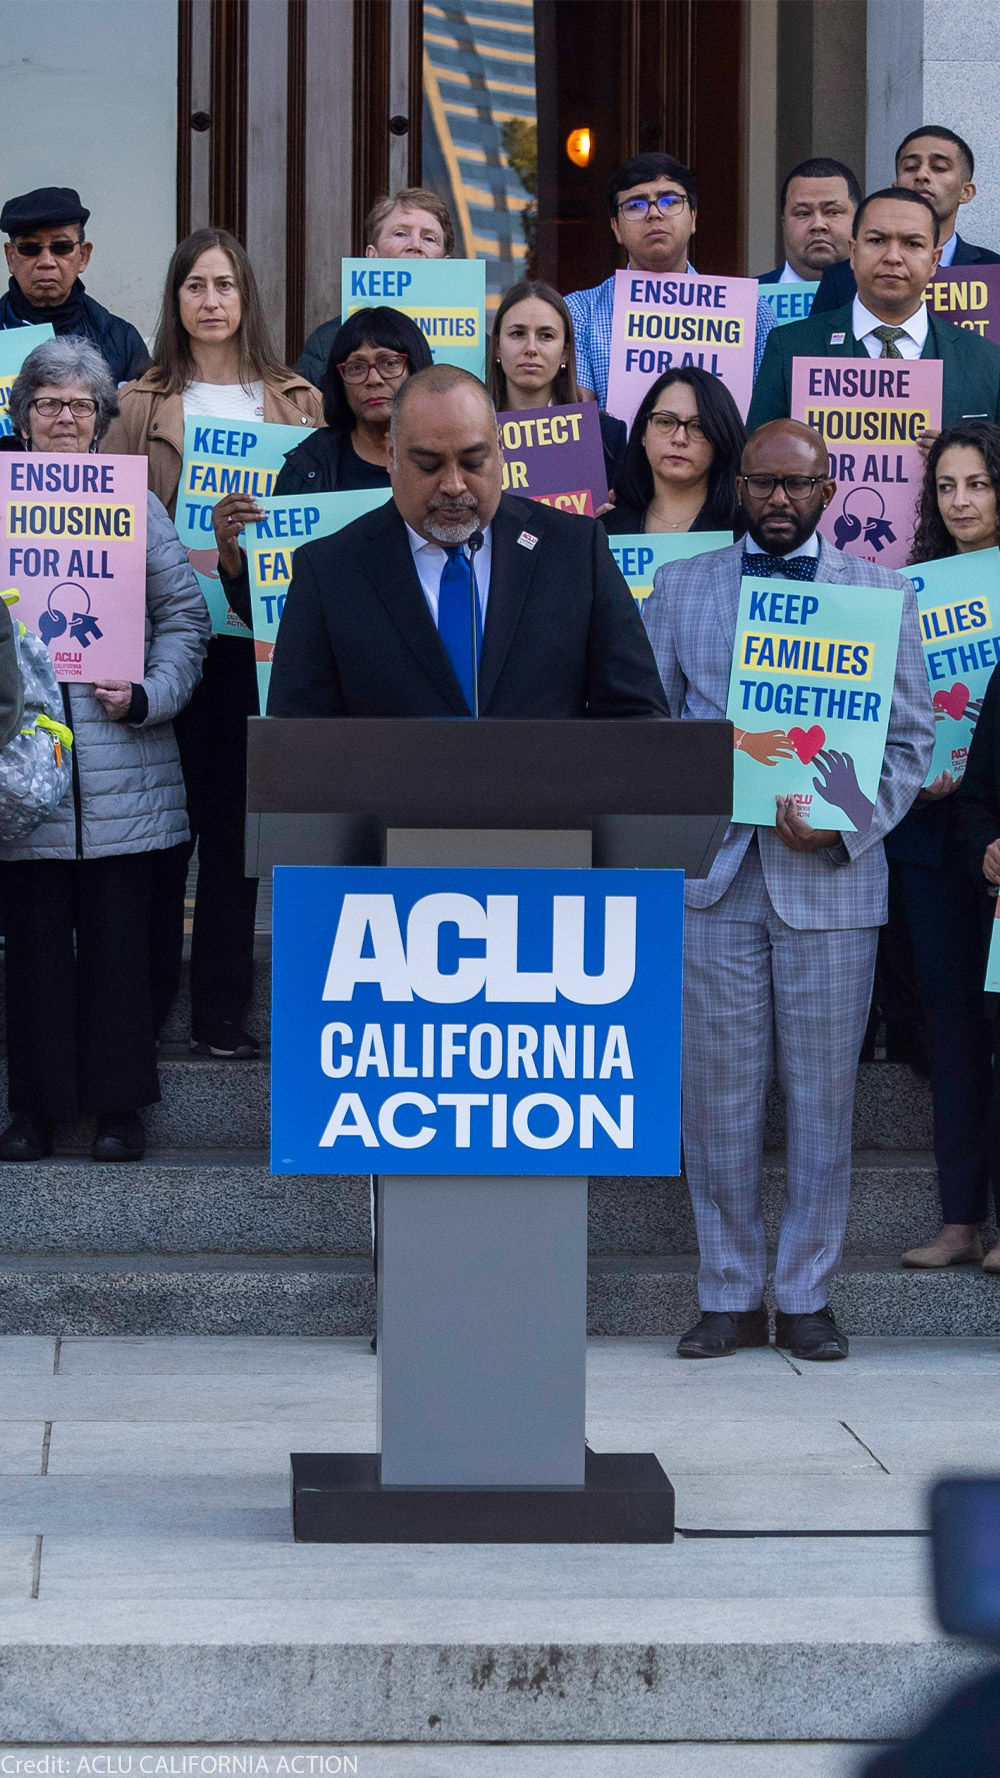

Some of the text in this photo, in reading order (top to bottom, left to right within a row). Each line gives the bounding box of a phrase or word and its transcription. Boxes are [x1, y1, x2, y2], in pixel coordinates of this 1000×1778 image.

[351, 270, 412, 297] KEEP
[630, 279, 727, 308] ENSURE
[413, 317, 476, 337] NITIES
[628, 314, 741, 344] HOUSING
[625, 349, 673, 374] FOR
[808, 368, 910, 398] ENSURE
[193, 427, 258, 457] KEEP
[501, 413, 583, 450] OTECT
[807, 411, 926, 441] HOUSING
[11, 463, 115, 493] ENSURE
[189, 465, 278, 497] FAMILI
[862, 455, 909, 483] ALL
[10, 505, 131, 537] HOUSING
[256, 507, 320, 539] KEEP
[9, 547, 114, 579] FOR ALL
[749, 590, 819, 625] KEEP
[921, 601, 987, 640] ILIES
[55, 652, 82, 662] ACLU
[744, 636, 869, 676] FAMILIES
[739, 680, 882, 722] TOGETHER
[322, 892, 637, 1005] ACLU
[320, 1021, 634, 1079] CALIFORNIA
[318, 1091, 634, 1149] ACTION
